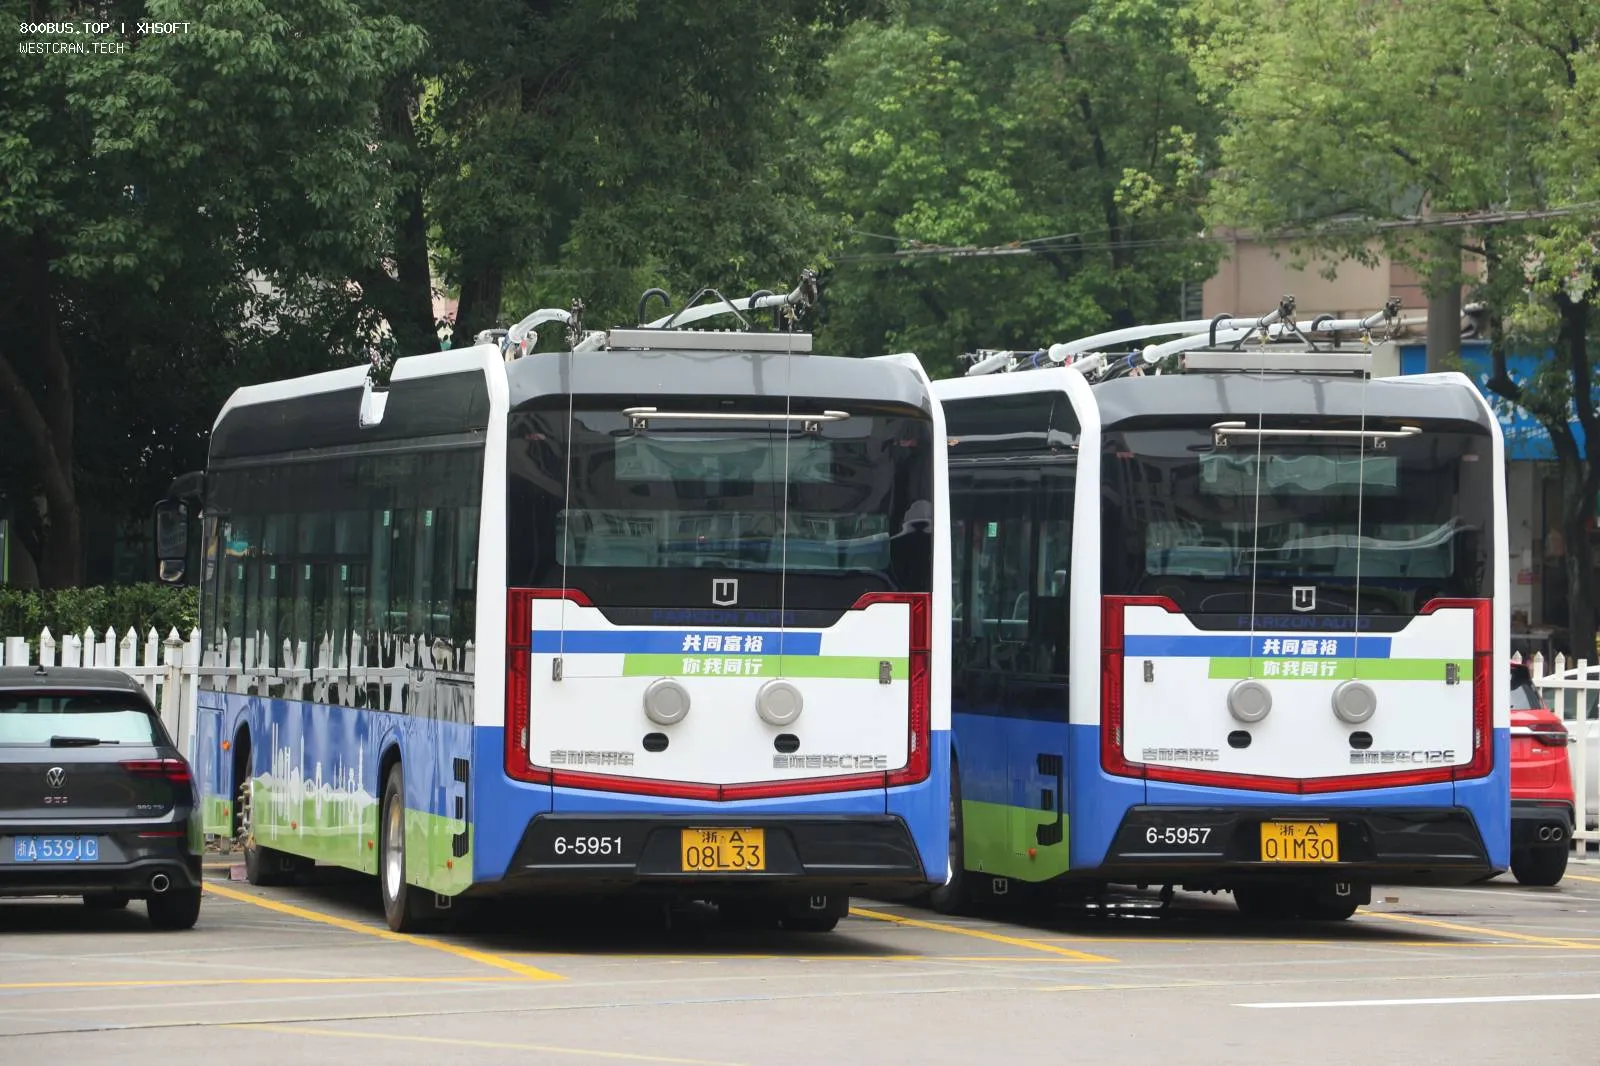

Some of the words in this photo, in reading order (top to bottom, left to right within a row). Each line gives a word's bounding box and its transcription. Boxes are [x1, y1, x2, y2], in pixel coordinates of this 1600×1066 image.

[1237, 615, 1317, 629] FARIZON
[1322, 616, 1371, 629] AUTO
[681, 633, 764, 653] 共同富裕
[1262, 638, 1338, 656] 共同富裕
[682, 657, 763, 675] 你我同行
[1263, 660, 1337, 677] 你我同行
[1146, 827, 1211, 844] 6-5957
[554, 836, 623, 855] 6-5951
[1265, 838, 1334, 859] 01M30
[686, 845, 760, 868] 08L33
